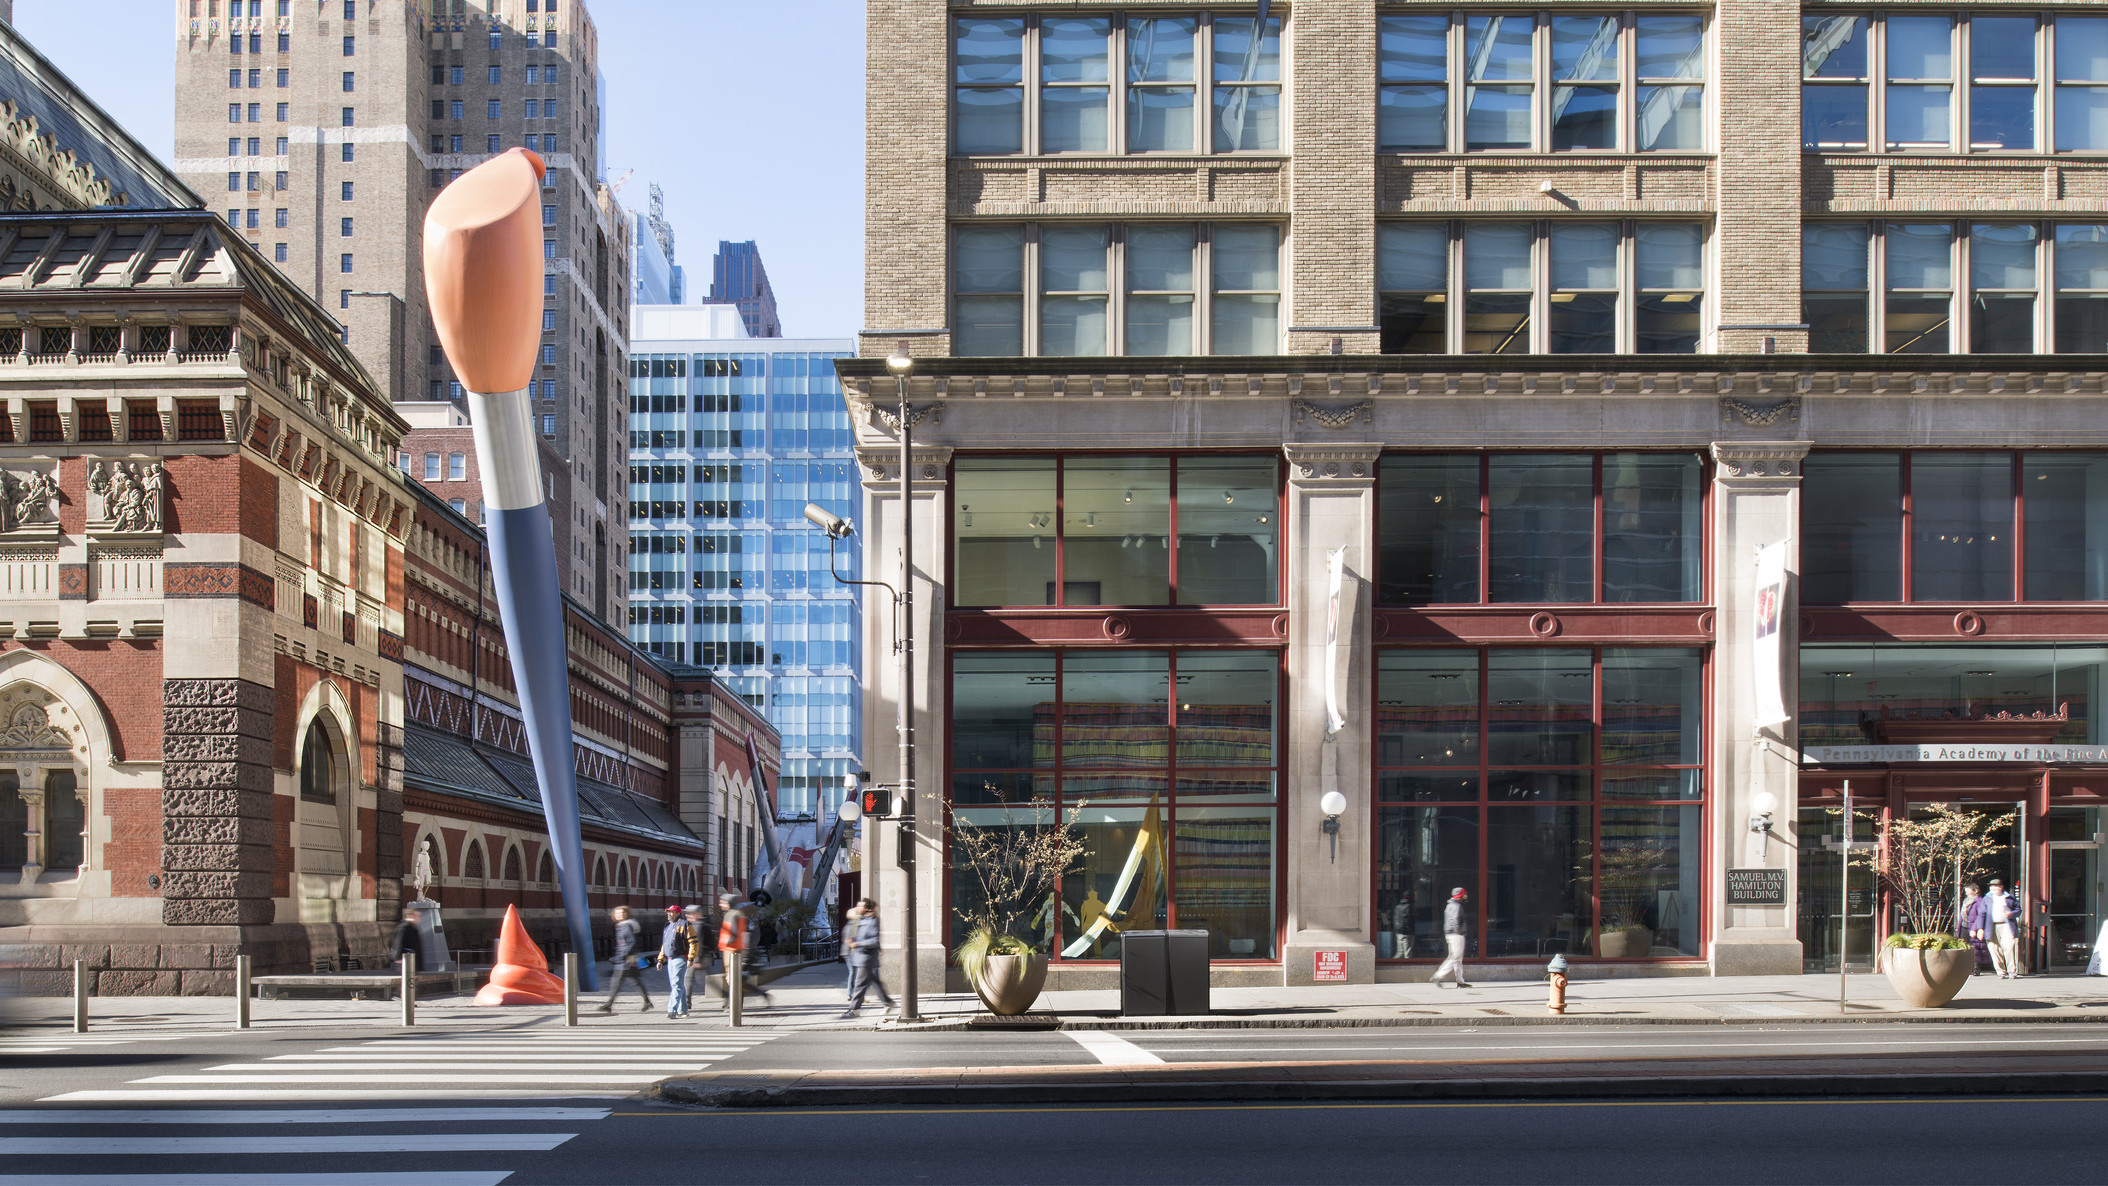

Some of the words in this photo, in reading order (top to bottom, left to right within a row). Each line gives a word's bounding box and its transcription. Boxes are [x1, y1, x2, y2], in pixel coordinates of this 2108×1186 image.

[1823, 747, 1930, 761] Pennsylvania
[1939, 747, 2006, 761] Academy
[2014, 747, 2029, 760] of
[2036, 747, 2060, 760] the
[2065, 748, 2093, 760] Fine
[1728, 872, 1766, 881] SAMUEL
[1731, 881, 1781, 890] HAMILTON
[1733, 890, 1779, 899] BUILDING
[1322, 952, 1340, 962] FDC
